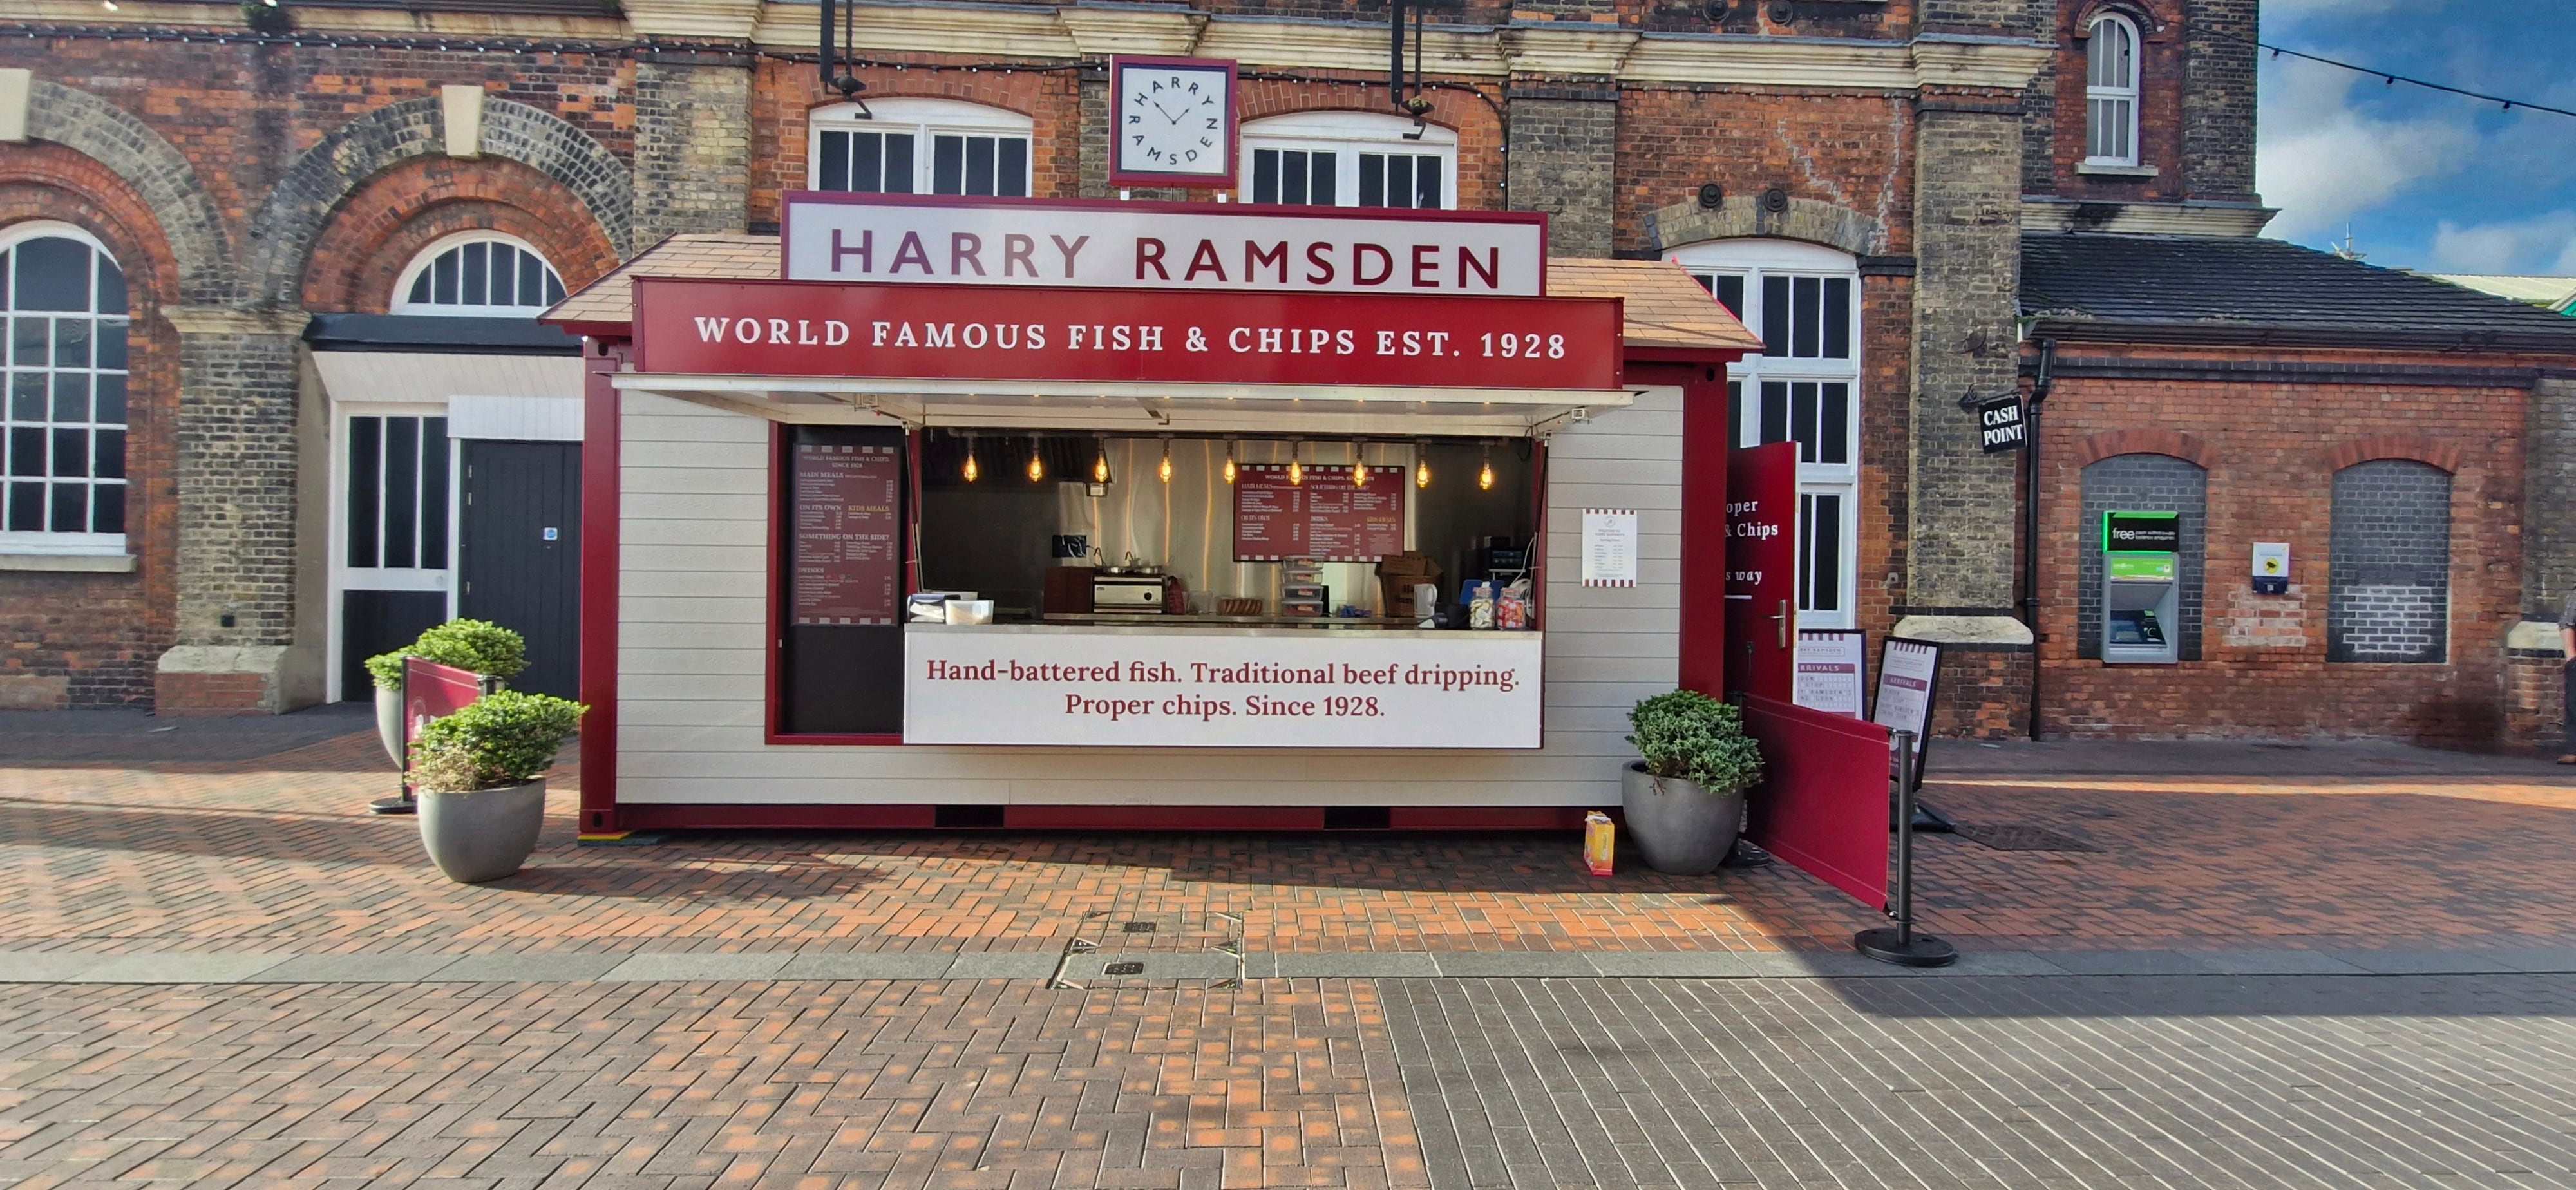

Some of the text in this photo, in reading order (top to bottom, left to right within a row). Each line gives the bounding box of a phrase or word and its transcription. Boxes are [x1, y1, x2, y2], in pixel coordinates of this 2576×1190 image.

[1134, 77, 1215, 106] HARRY
[1129, 115, 1218, 165] RAMSDEN
[831, 229, 1499, 289] HARRY RAMSDEN
[694, 316, 1565, 359] WORLD FAMOUS FISH & CHIPS EST. 1928
[1984, 405, 2019, 426] CASH
[1983, 424, 2023, 446] POINT
[1726, 501, 1758, 516] oper
[1725, 522, 1779, 540] & Chips
[2112, 527, 2135, 540] free
[1735, 571, 1762, 585] way
[927, 659, 1520, 692] Hand-battered fish. Traditional beef dripping.
[1889, 677, 1917, 688] ARRIVALS
[1065, 694, 1385, 722] Proper chips. Since 1928.
